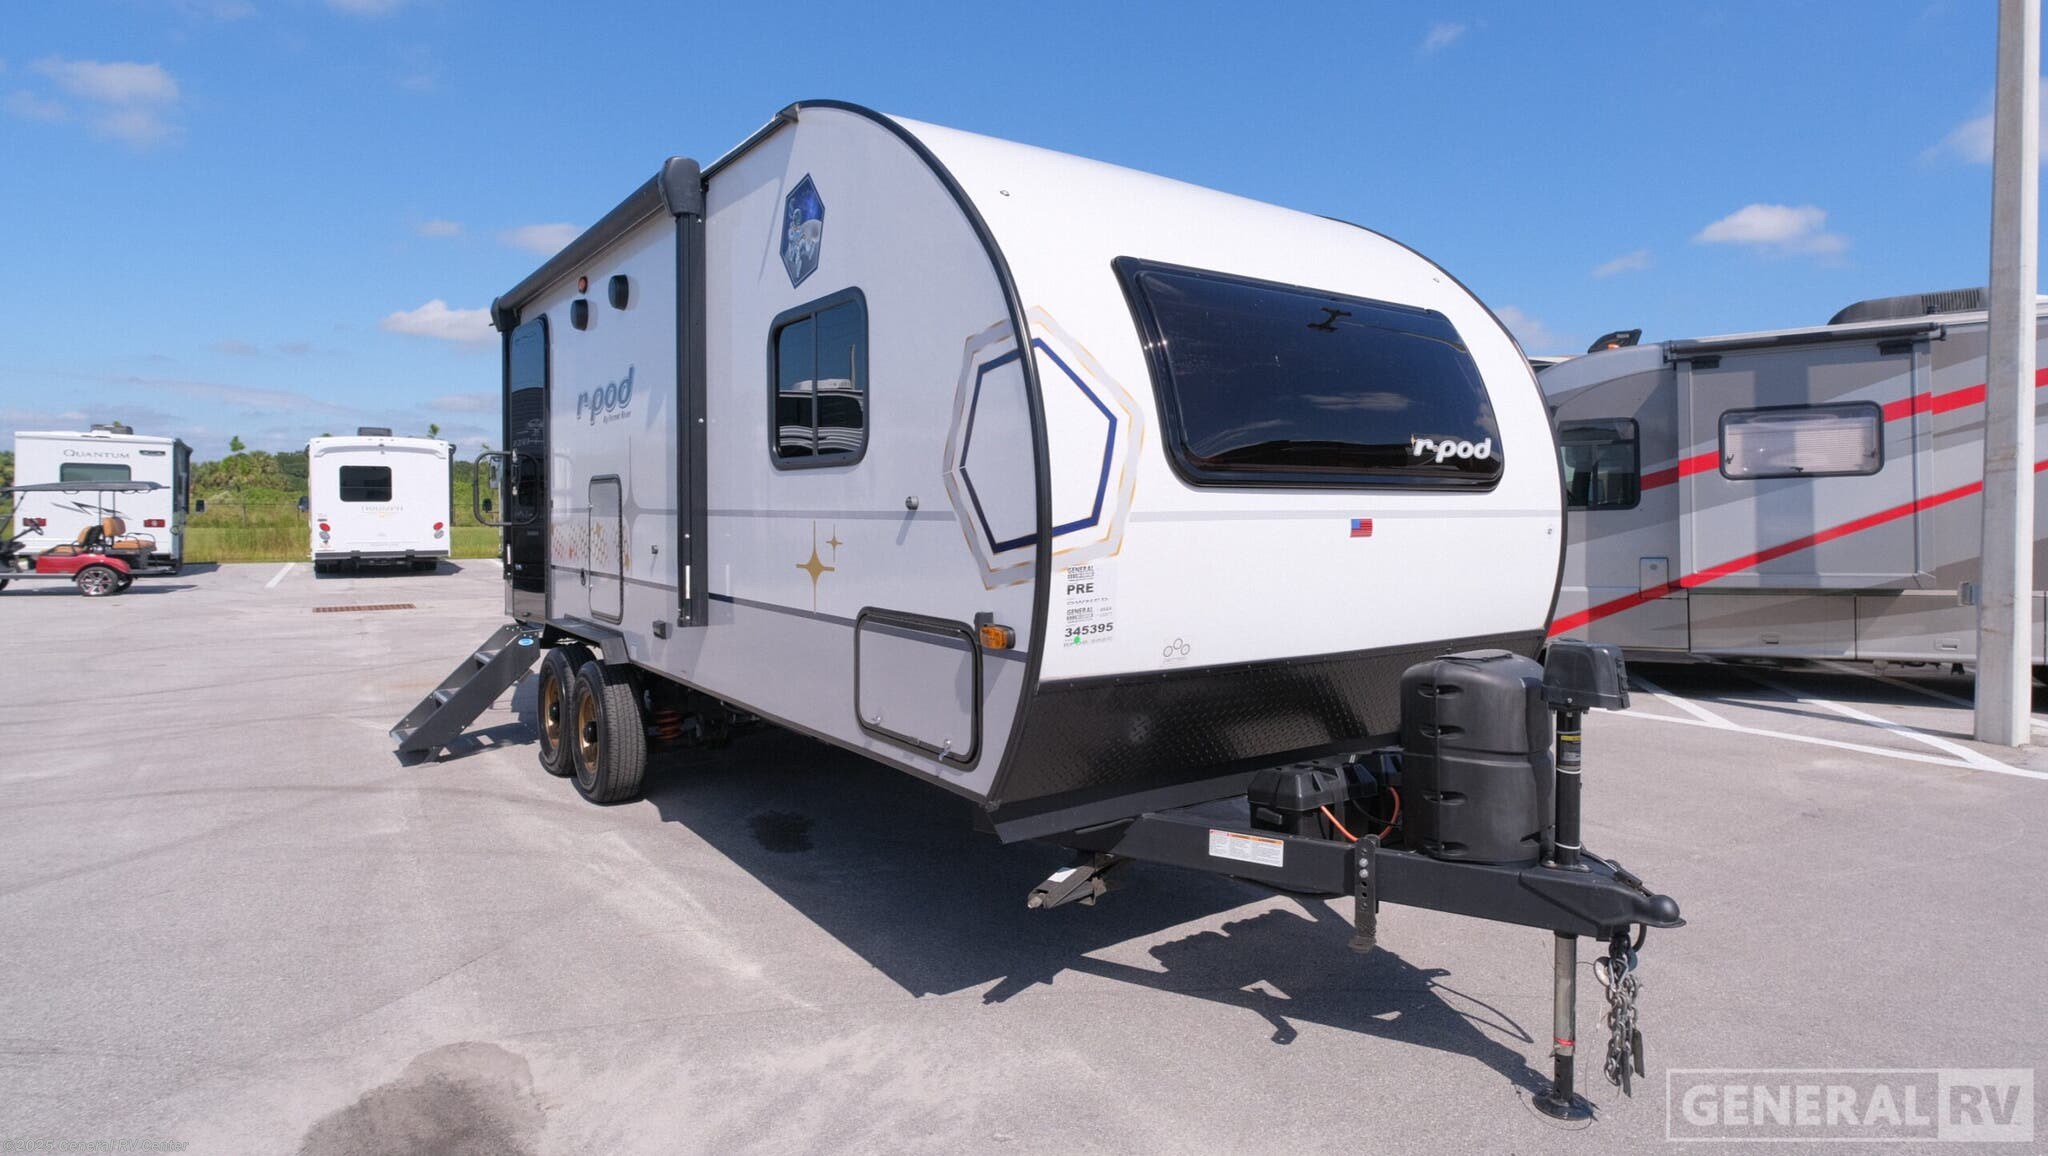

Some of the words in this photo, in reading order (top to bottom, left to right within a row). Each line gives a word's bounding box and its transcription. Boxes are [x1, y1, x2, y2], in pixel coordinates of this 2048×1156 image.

[63, 449, 130, 459] QUANTUM
[1412, 437, 1492, 463] r-pod
[1067, 582, 1094, 595] PRE
[1064, 622, 1114, 637] 345395
